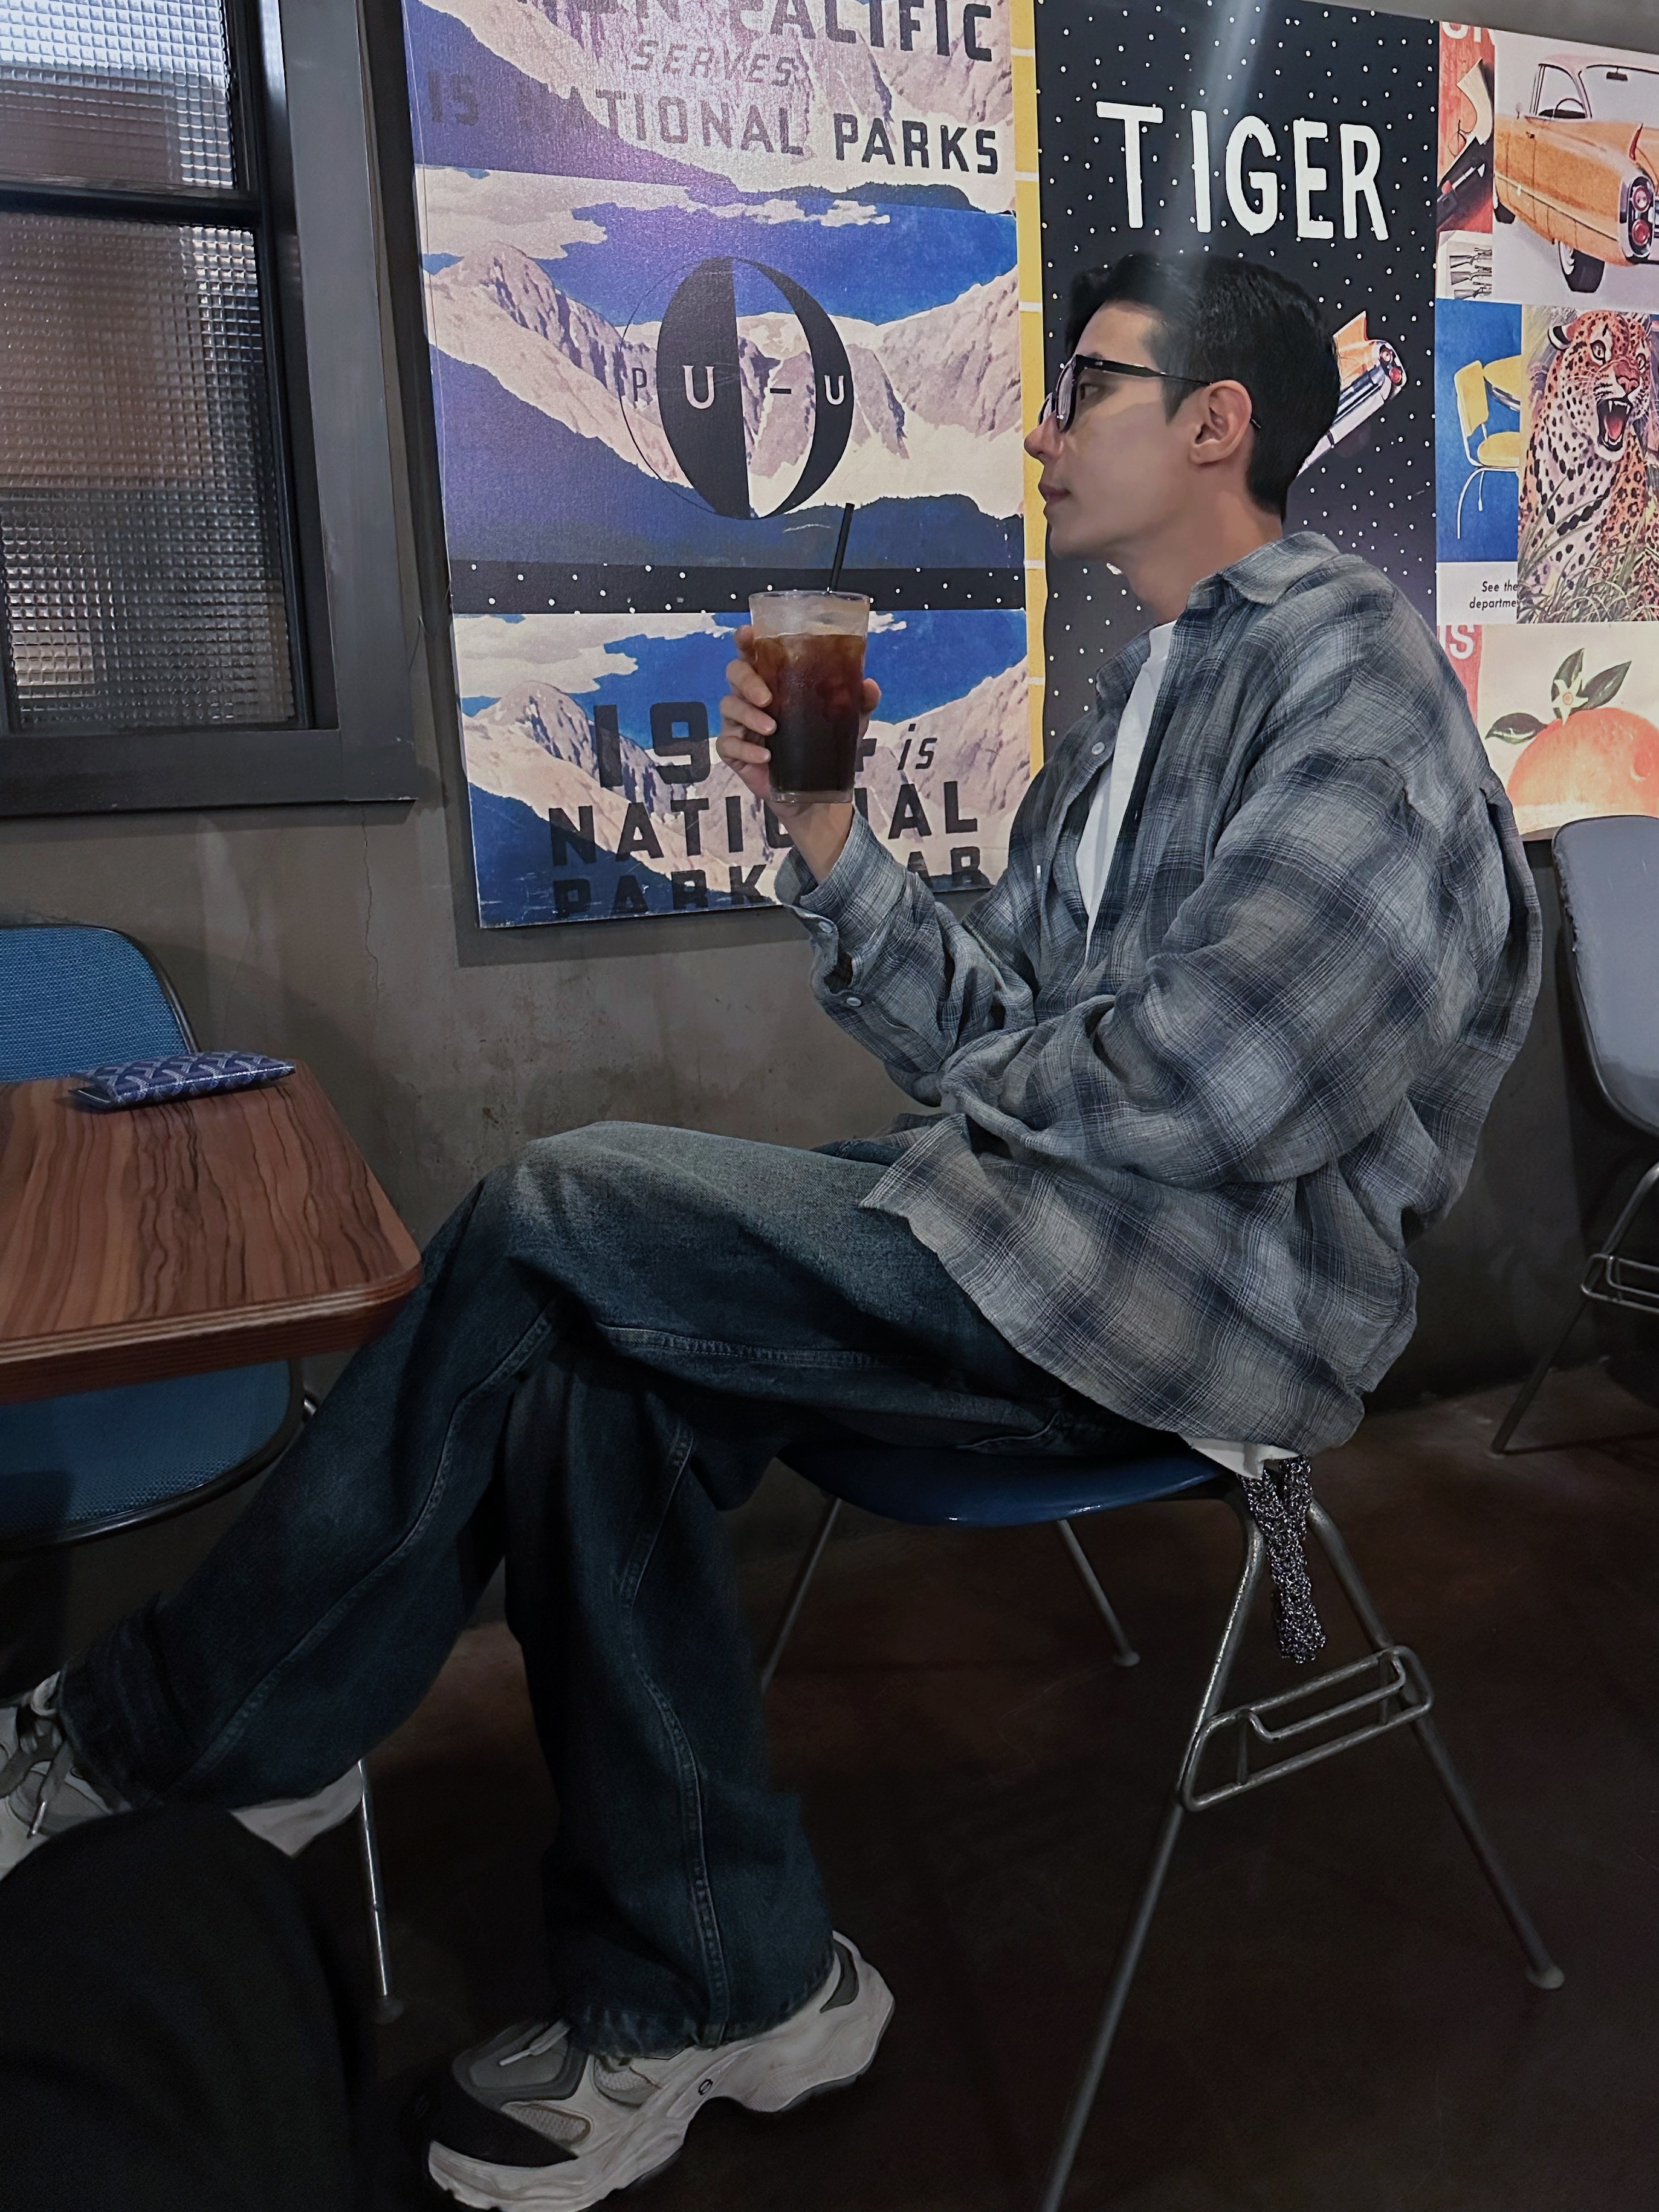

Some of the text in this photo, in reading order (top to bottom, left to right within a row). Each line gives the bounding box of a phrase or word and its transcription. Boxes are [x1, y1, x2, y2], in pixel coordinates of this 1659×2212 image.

[833, 112, 998, 175] PARKS
[1096, 101, 1389, 241] TIGER
[1482, 580, 1518, 592] See the
[897, 723, 938, 771] is
[548, 781, 978, 867] NATIAL
